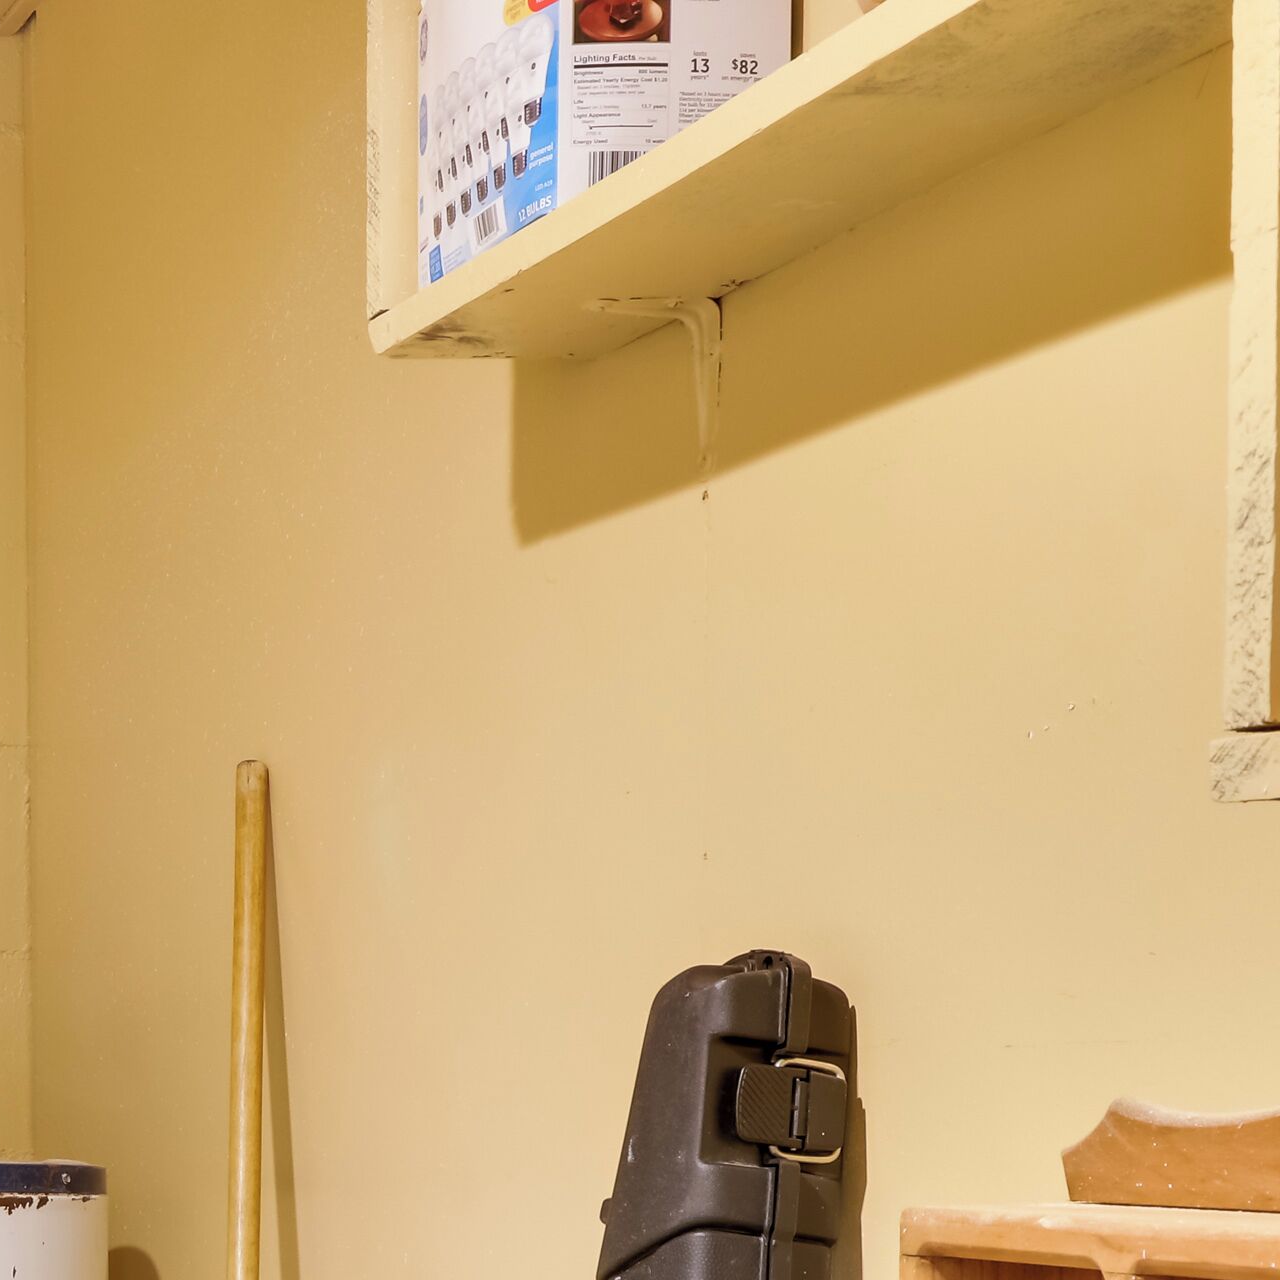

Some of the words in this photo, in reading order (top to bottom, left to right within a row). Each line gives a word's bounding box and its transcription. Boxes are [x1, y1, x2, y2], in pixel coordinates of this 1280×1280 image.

[573, 55, 610, 64] Lighting
[612, 53, 637, 61] Facts
[691, 58, 710, 73] 13
[731, 58, 759, 75] $82
[530, 142, 553, 160] general
[528, 153, 553, 171] purpose
[518, 208, 526, 222] 12
[526, 195, 552, 218] BULBS
